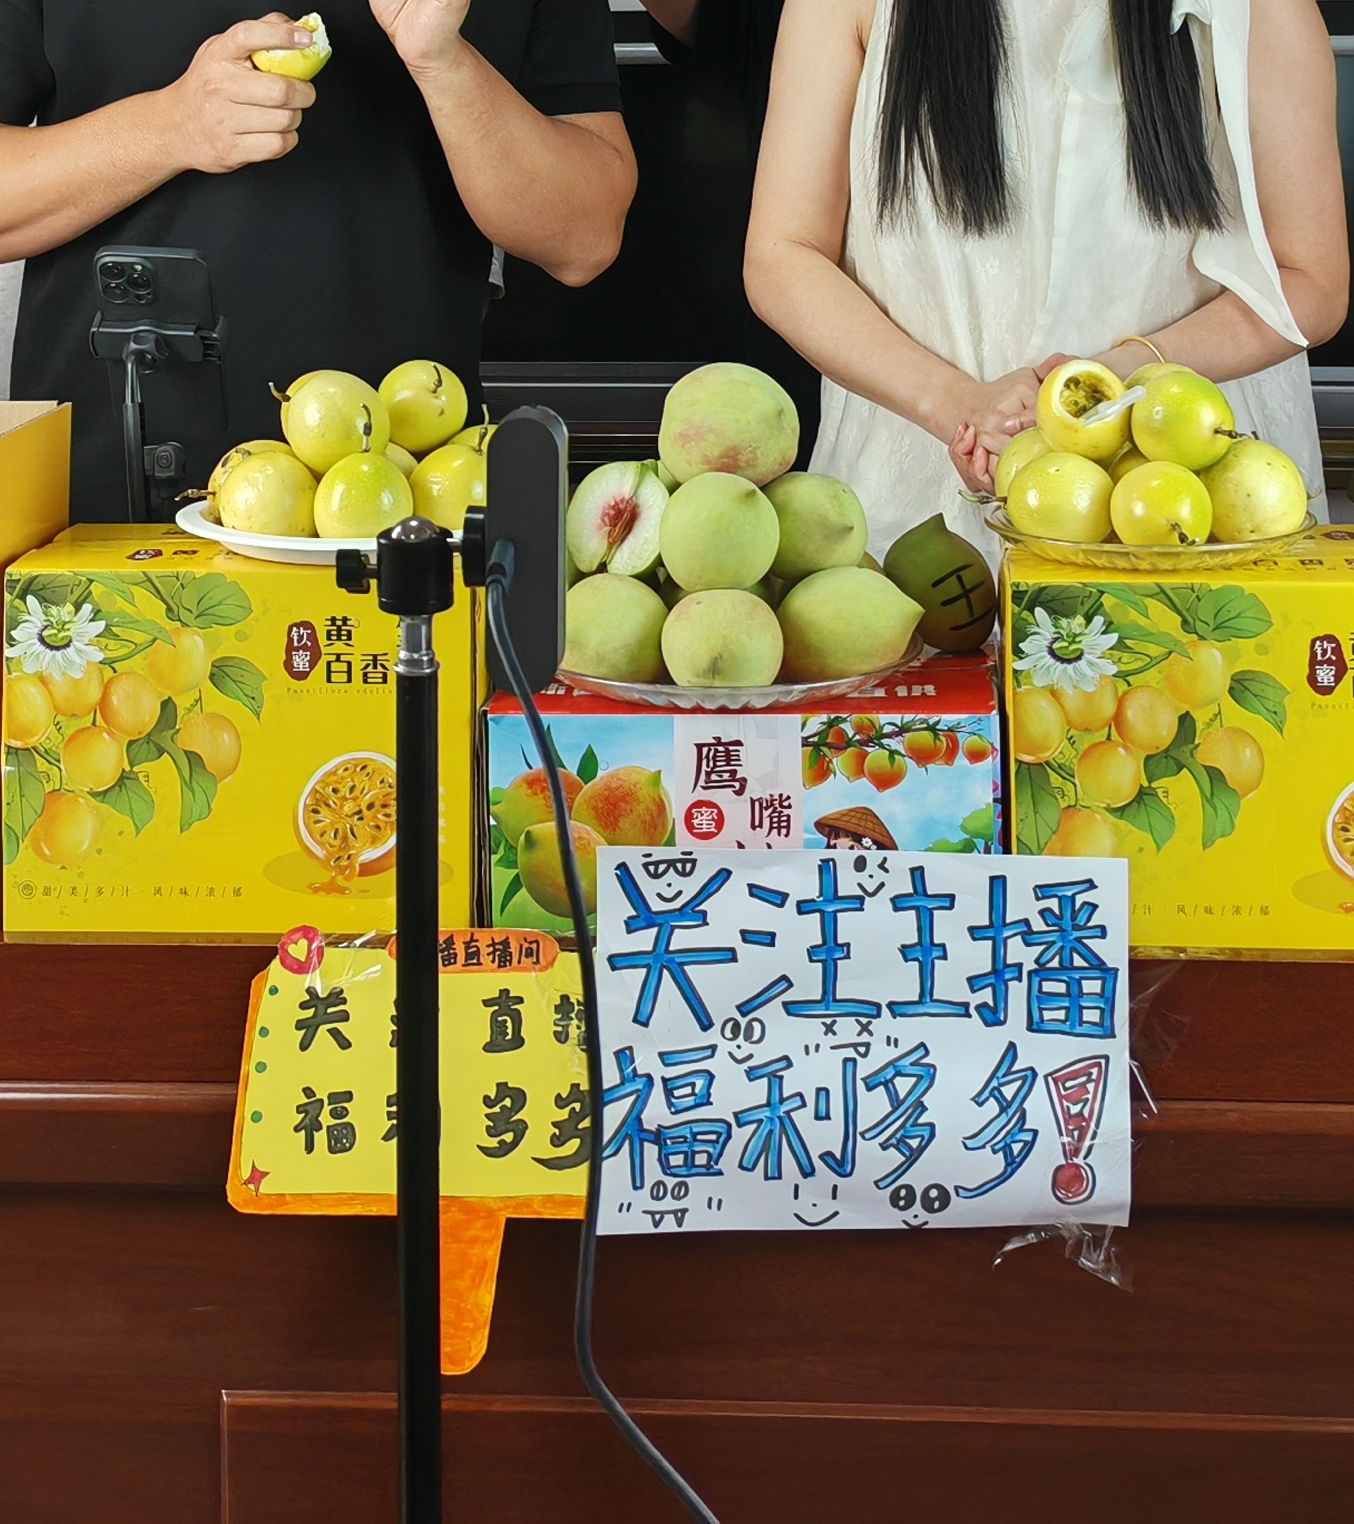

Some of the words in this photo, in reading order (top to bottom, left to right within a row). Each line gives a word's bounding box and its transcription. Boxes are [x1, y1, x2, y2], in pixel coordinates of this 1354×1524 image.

[290, 626, 313, 672] 钦蜜
[1313, 640, 1337, 687] 钦蜜
[690, 806, 718, 833] 蜜
[607, 858, 1120, 1038] 关注主播
